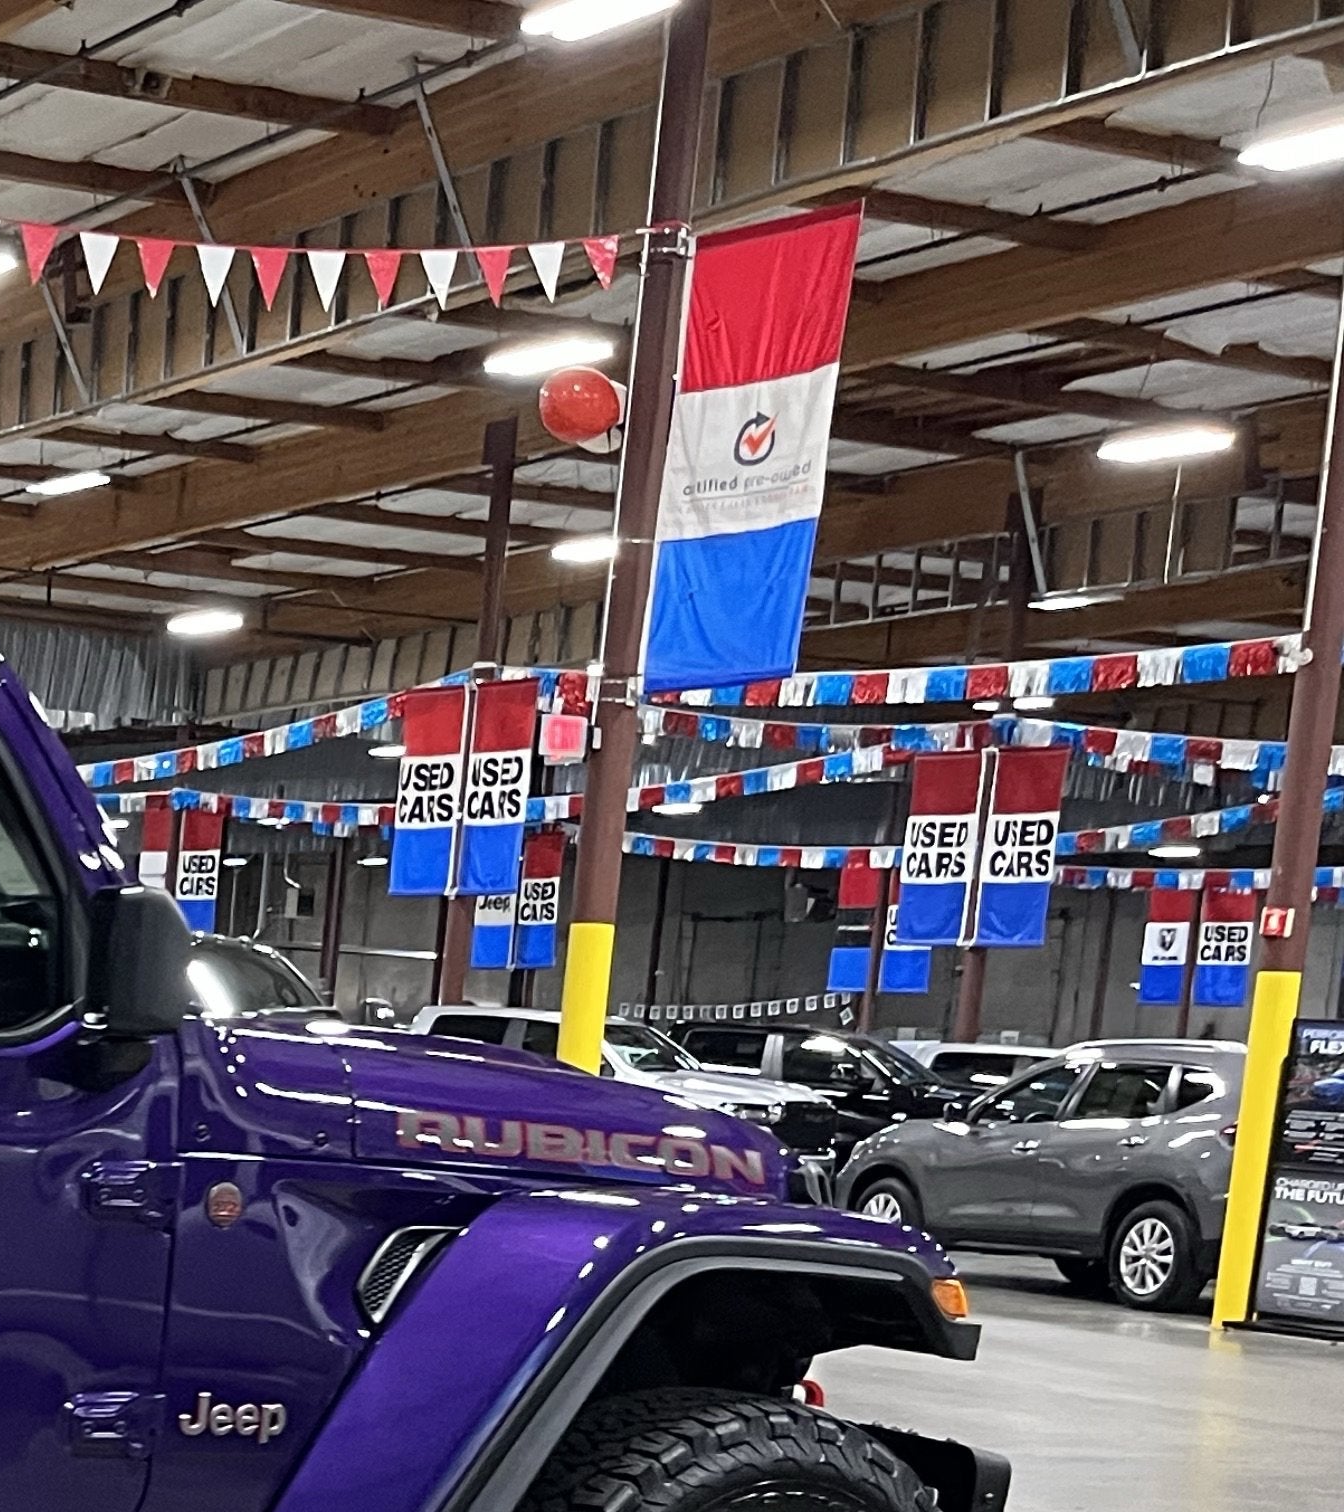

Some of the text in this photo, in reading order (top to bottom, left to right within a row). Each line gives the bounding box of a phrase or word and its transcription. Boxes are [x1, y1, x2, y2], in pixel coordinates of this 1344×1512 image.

[400, 762, 455, 791] USED
[472, 756, 523, 787] USED
[399, 793, 453, 823] CARS
[467, 788, 522, 820] CARS
[910, 822, 968, 848] USED
[994, 819, 1054, 847] USED
[182, 855, 216, 874] USED
[906, 851, 966, 878] CARS
[989, 849, 1051, 877] CARS
[524, 881, 556, 900] USED
[1204, 925, 1249, 942] USED
[1200, 945, 1247, 961] CARS
[396, 1110, 765, 1185] RUBICON
[1274, 1186, 1305, 1201] THE
[179, 1392, 286, 1443] Jeep
